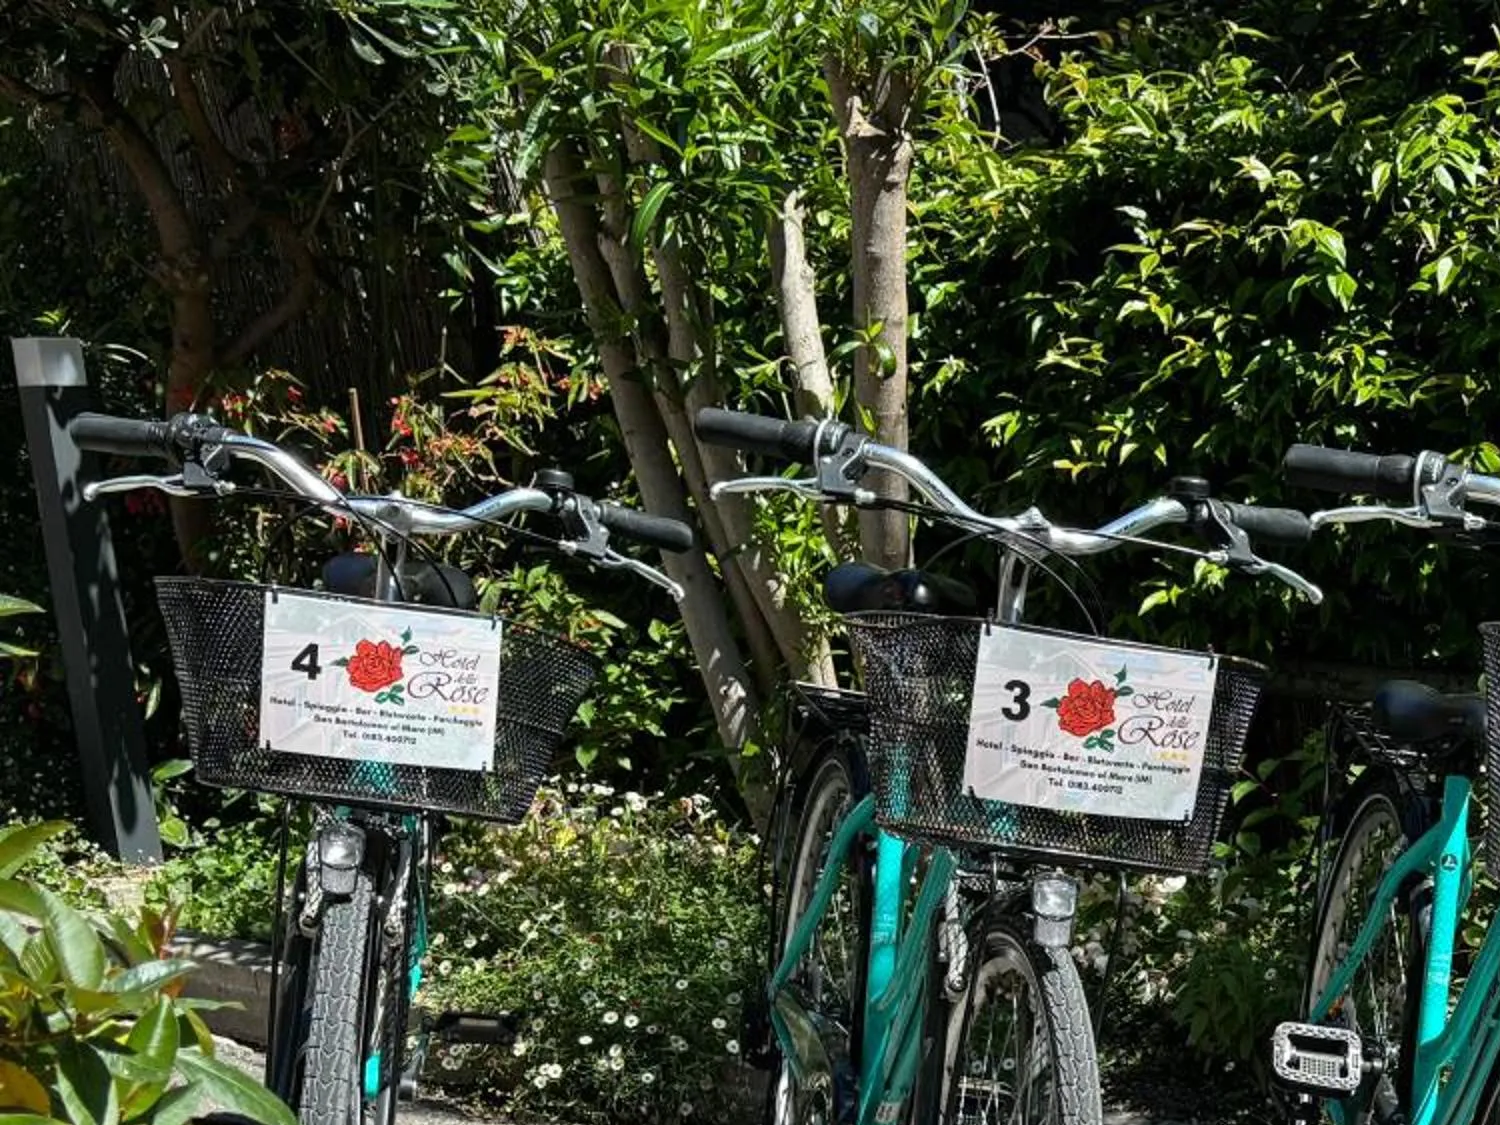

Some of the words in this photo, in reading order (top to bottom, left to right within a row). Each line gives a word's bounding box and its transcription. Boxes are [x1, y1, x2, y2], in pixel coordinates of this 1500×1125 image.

[291, 643, 322, 680] 4
[419, 649, 480, 670] Hotel
[270, 696, 295, 706] Hotel
[407, 671, 488, 704] Rose
[1001, 679, 1030, 722] 3
[1132, 689, 1195, 713] Hotel
[976, 739, 1002, 749] Hotel
[1117, 715, 1200, 750] Rose
